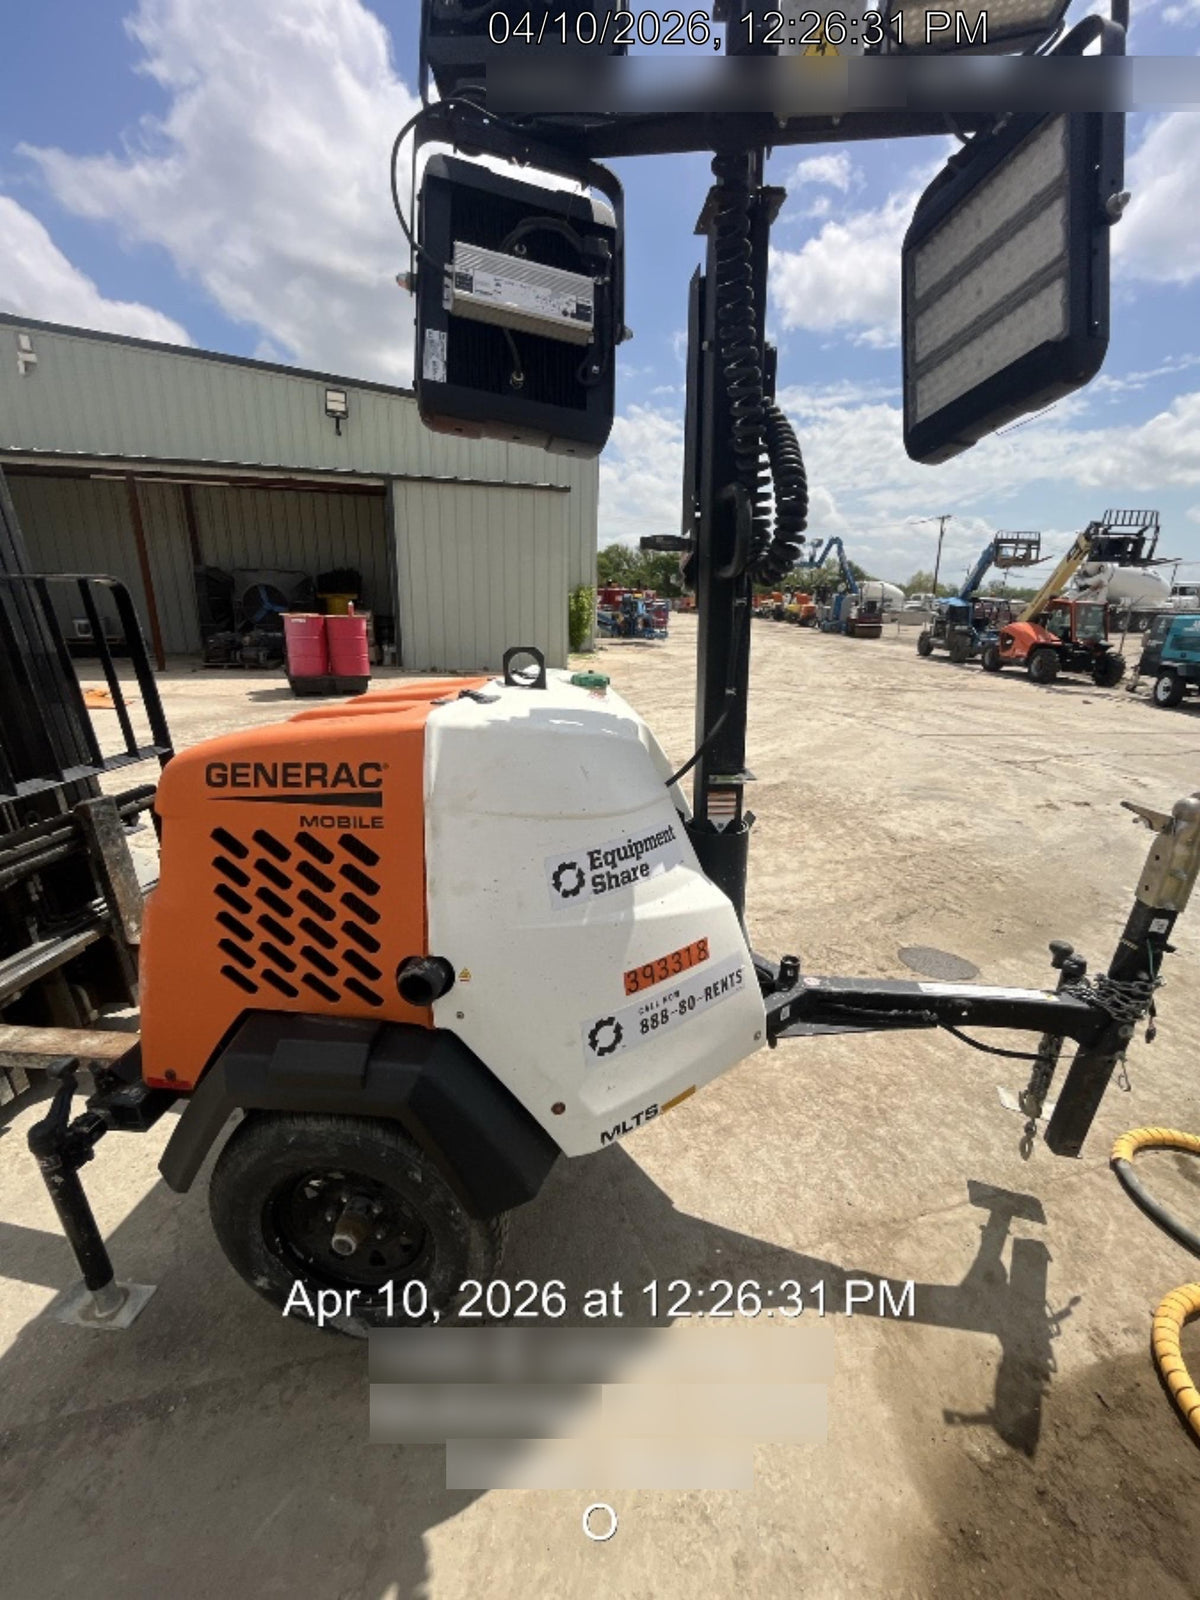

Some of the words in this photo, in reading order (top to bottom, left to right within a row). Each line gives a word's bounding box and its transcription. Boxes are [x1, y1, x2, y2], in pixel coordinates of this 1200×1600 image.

[205, 762, 383, 788] GENERAC
[299, 815, 385, 829] MOBILE
[587, 824, 677, 871] Equipment
[591, 862, 650, 895] Share
[626, 939, 708, 994] 393318
[639, 968, 743, 1035] 888-80-RENTS
[600, 1103, 659, 1145] MLTS
